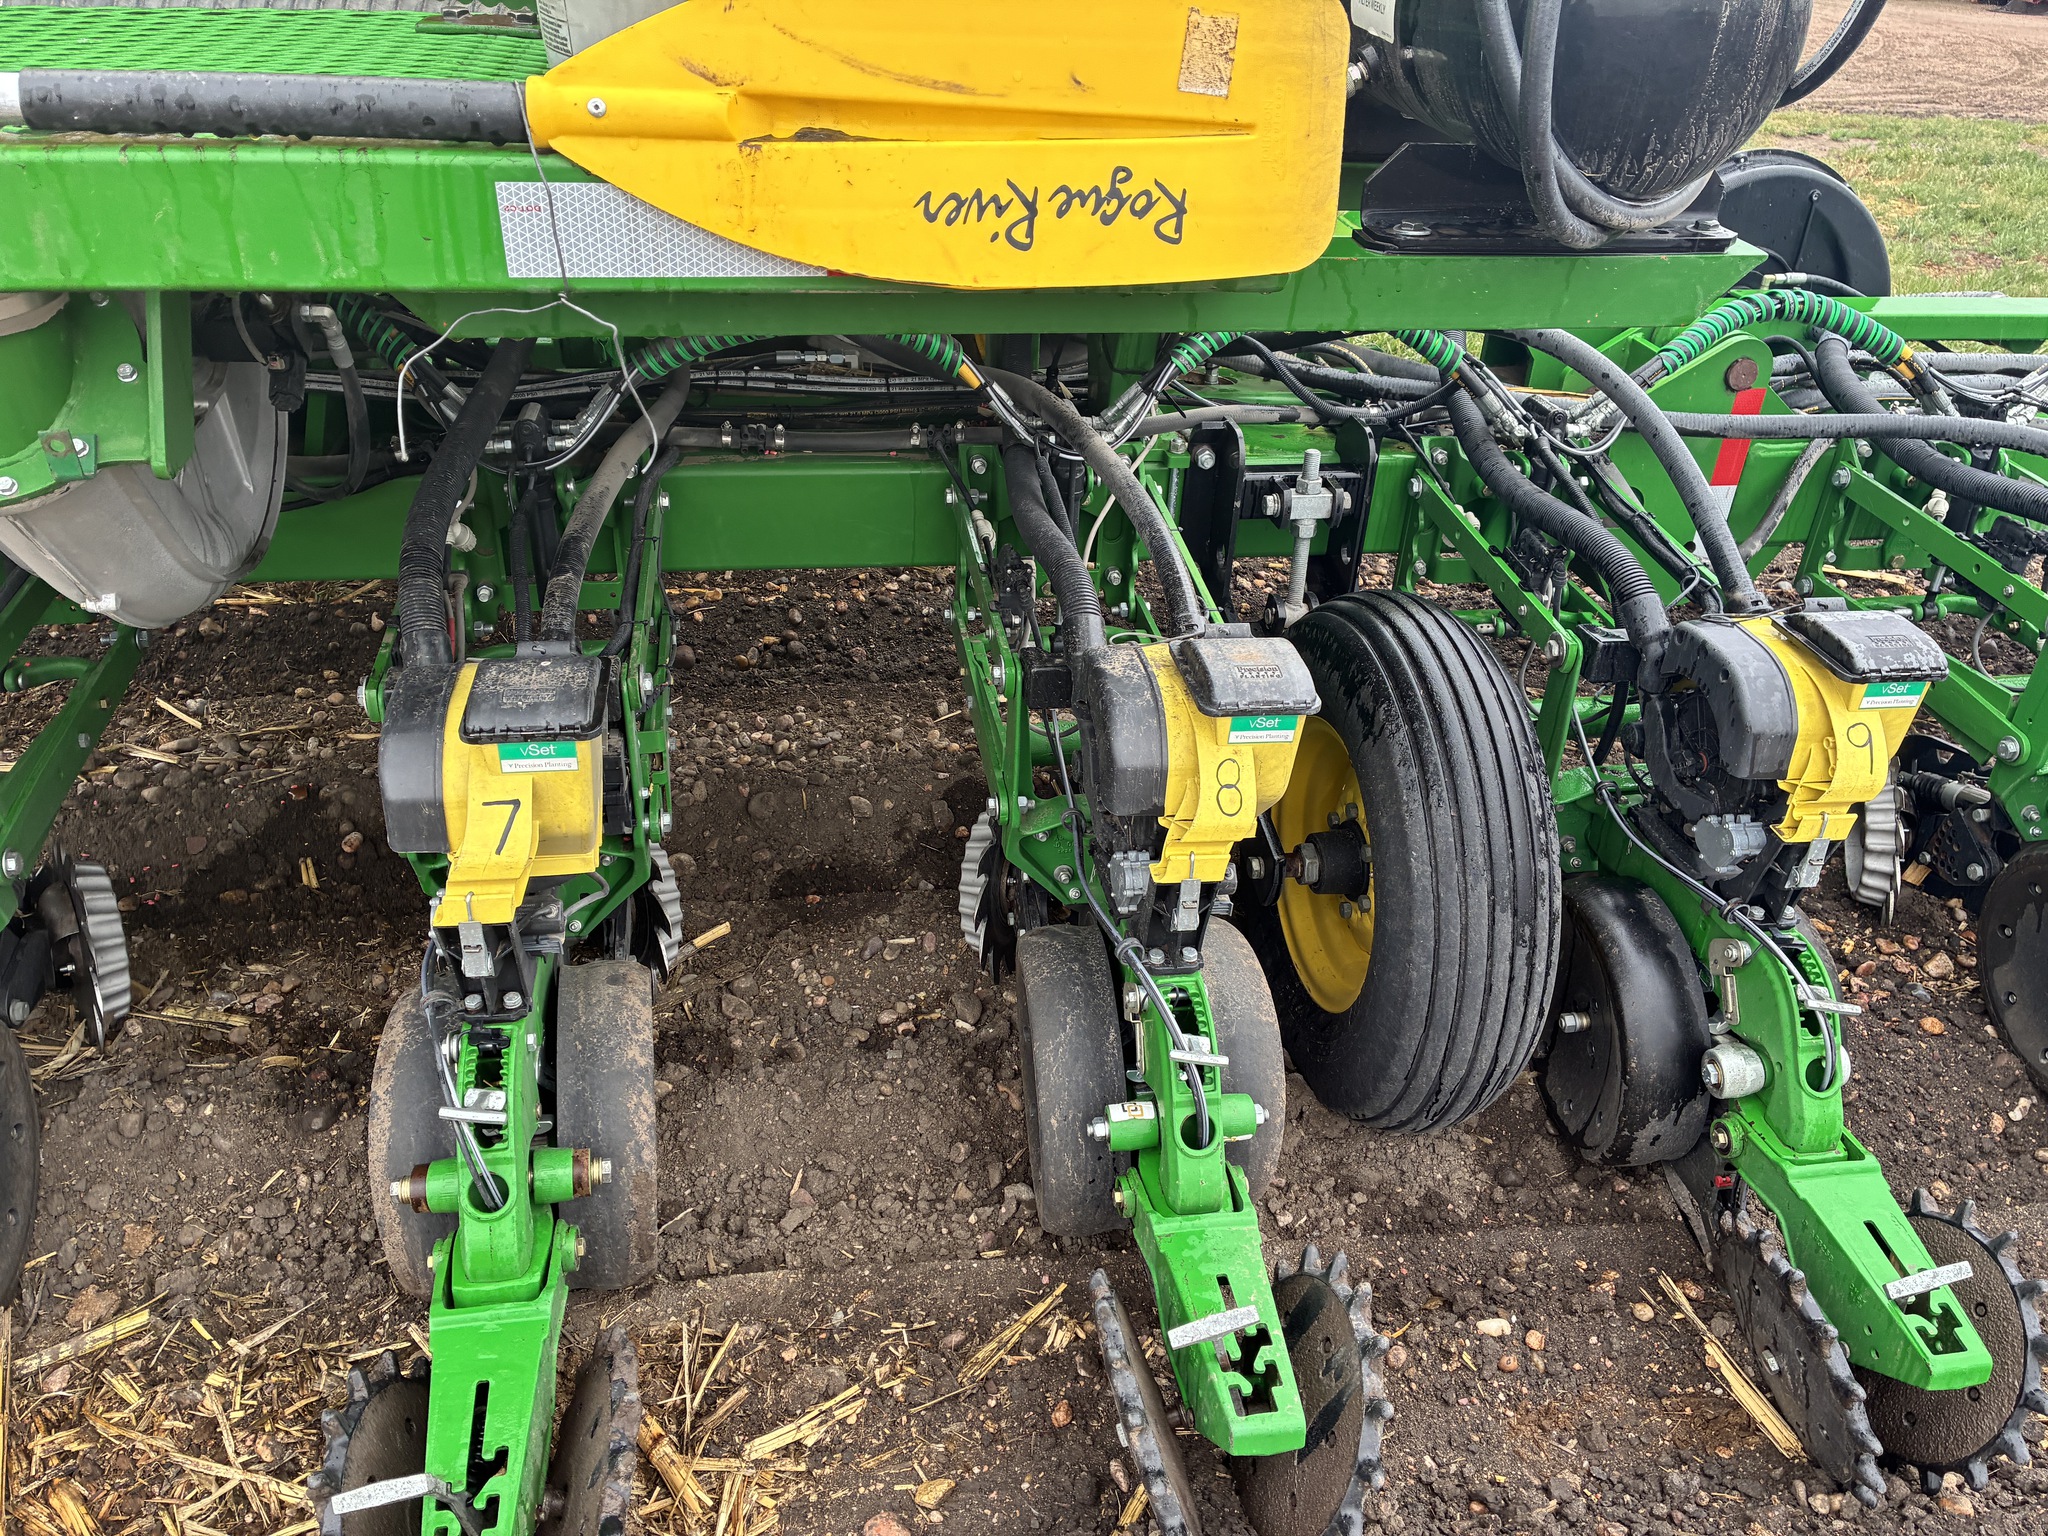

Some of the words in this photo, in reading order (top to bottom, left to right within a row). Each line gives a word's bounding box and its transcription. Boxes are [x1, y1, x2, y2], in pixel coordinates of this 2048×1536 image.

[913, 178, 1038, 251] River
[1047, 165, 1187, 245] Rogue
[1882, 683, 1911, 694] vSet
[520, 744, 557, 756] vSet
[1249, 717, 1281, 728] vSet
[1847, 722, 1874, 775] 9
[1216, 758, 1243, 817] 8
[482, 798, 521, 855] 7
